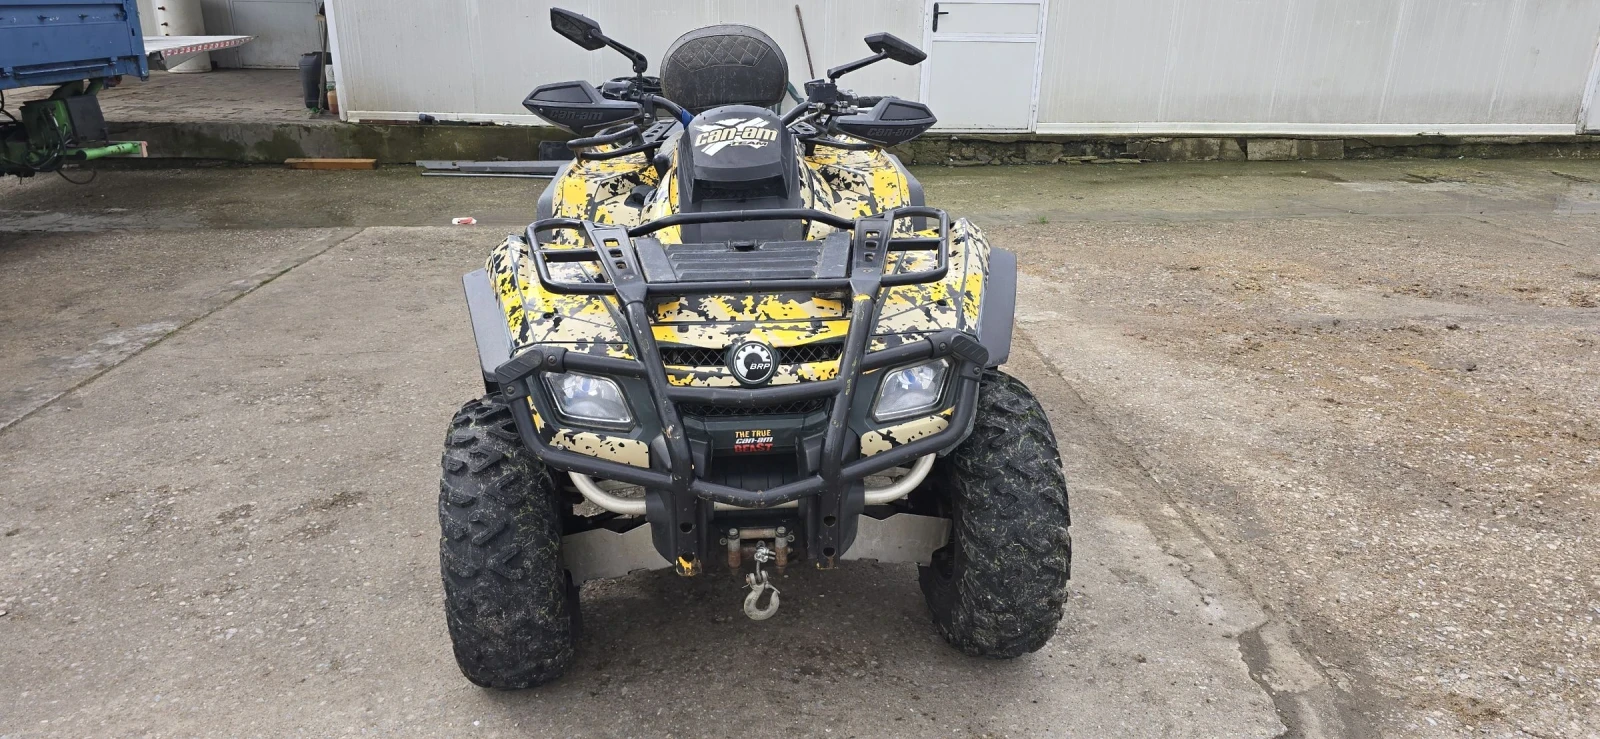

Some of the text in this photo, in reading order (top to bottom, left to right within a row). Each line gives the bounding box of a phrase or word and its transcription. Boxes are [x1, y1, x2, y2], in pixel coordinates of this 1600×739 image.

[695, 126, 778, 146] can-am
[735, 429, 772, 438] THE TRUE
[735, 436, 774, 444] can-am
[734, 442, 774, 452] BEAST
